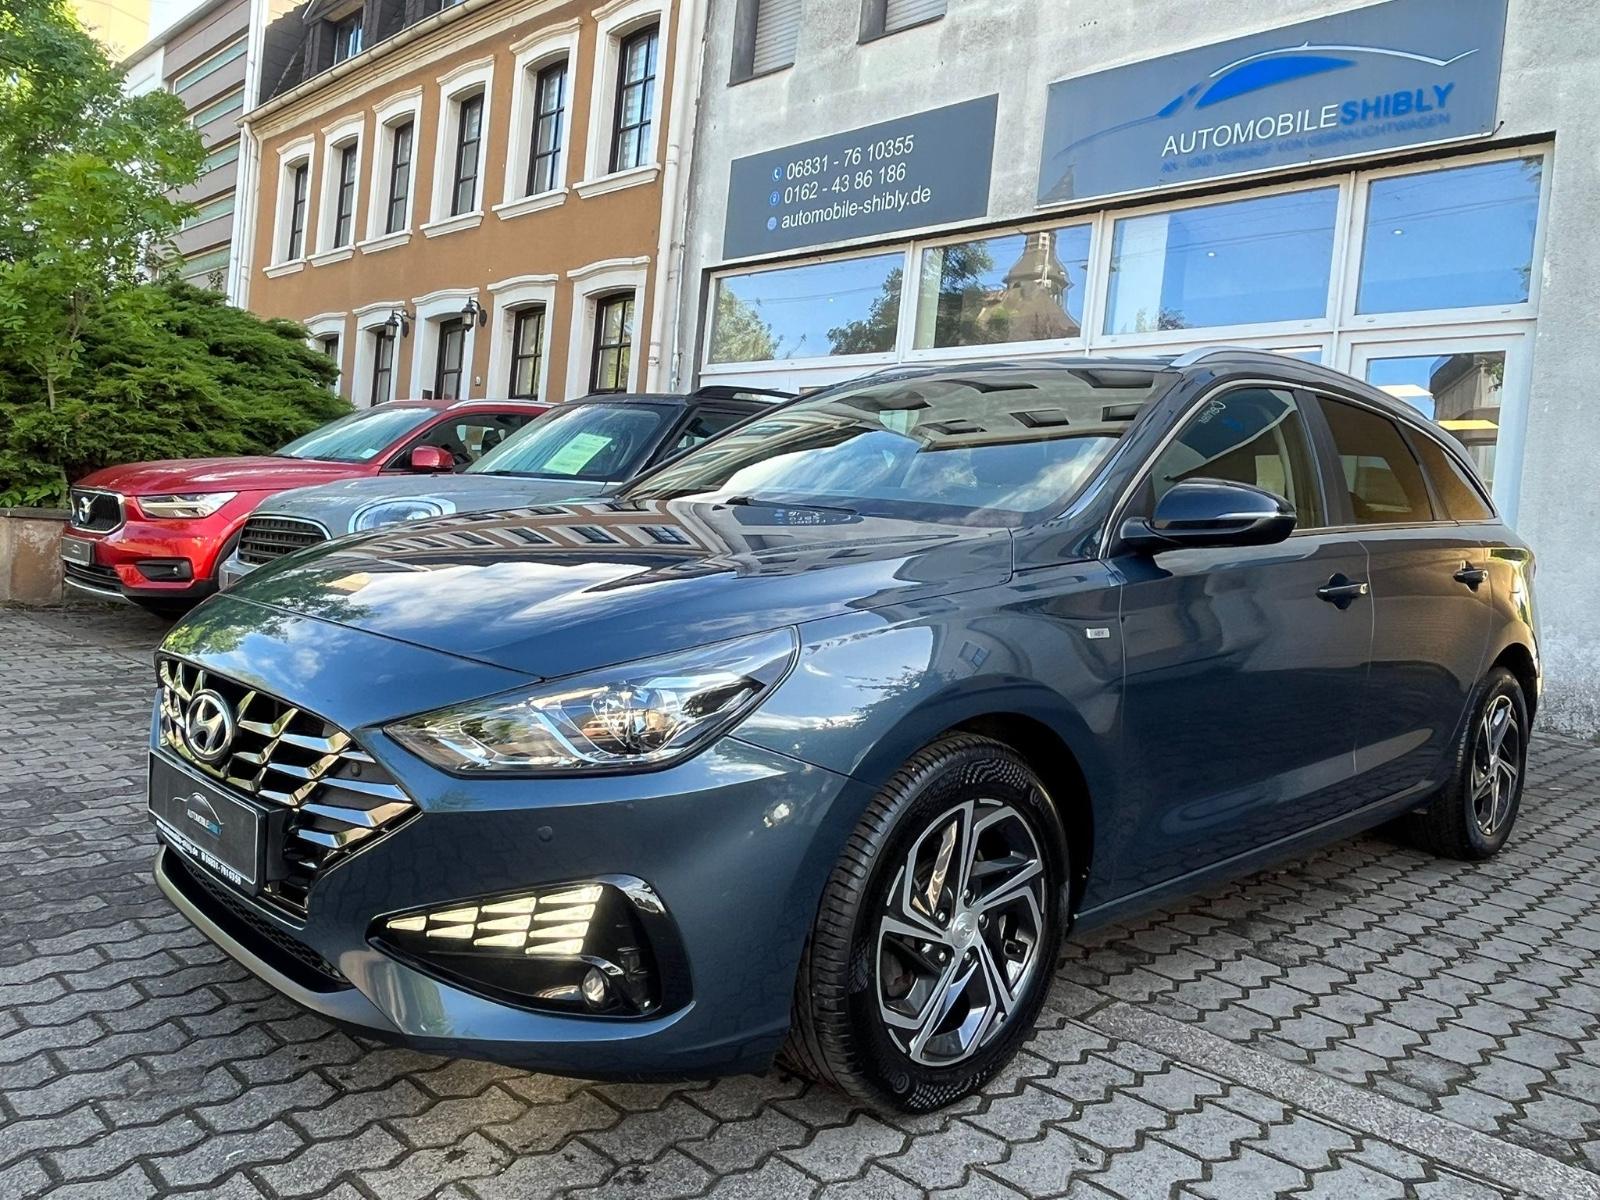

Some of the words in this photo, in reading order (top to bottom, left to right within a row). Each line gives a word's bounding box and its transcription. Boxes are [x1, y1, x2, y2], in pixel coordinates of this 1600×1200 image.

[786, 154, 829, 181] 06831
[843, 147, 862, 169] 76
[866, 134, 914, 163] 10355
[784, 181, 819, 204] 0162
[831, 174, 850, 195] 43
[854, 169, 873, 191] 86
[879, 162, 906, 184] 186
[781, 184, 931, 229] automobile-shibly.de
